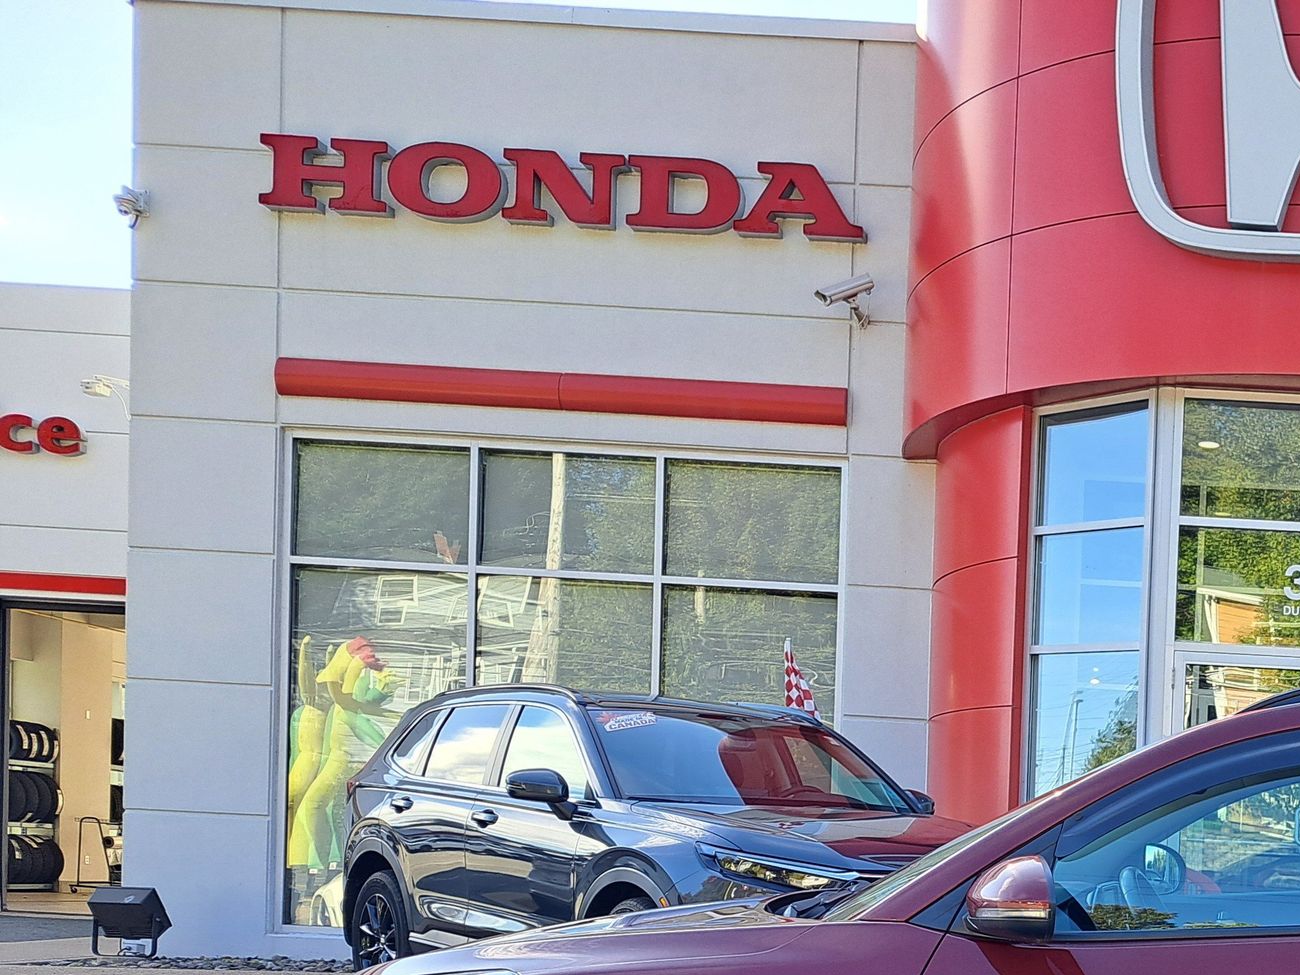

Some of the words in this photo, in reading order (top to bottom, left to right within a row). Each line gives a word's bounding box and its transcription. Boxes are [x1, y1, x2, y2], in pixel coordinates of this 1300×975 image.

[259, 133, 867, 244] HONDA
[0, 413, 86, 457] ce
[608, 718, 656, 730] CANADA
